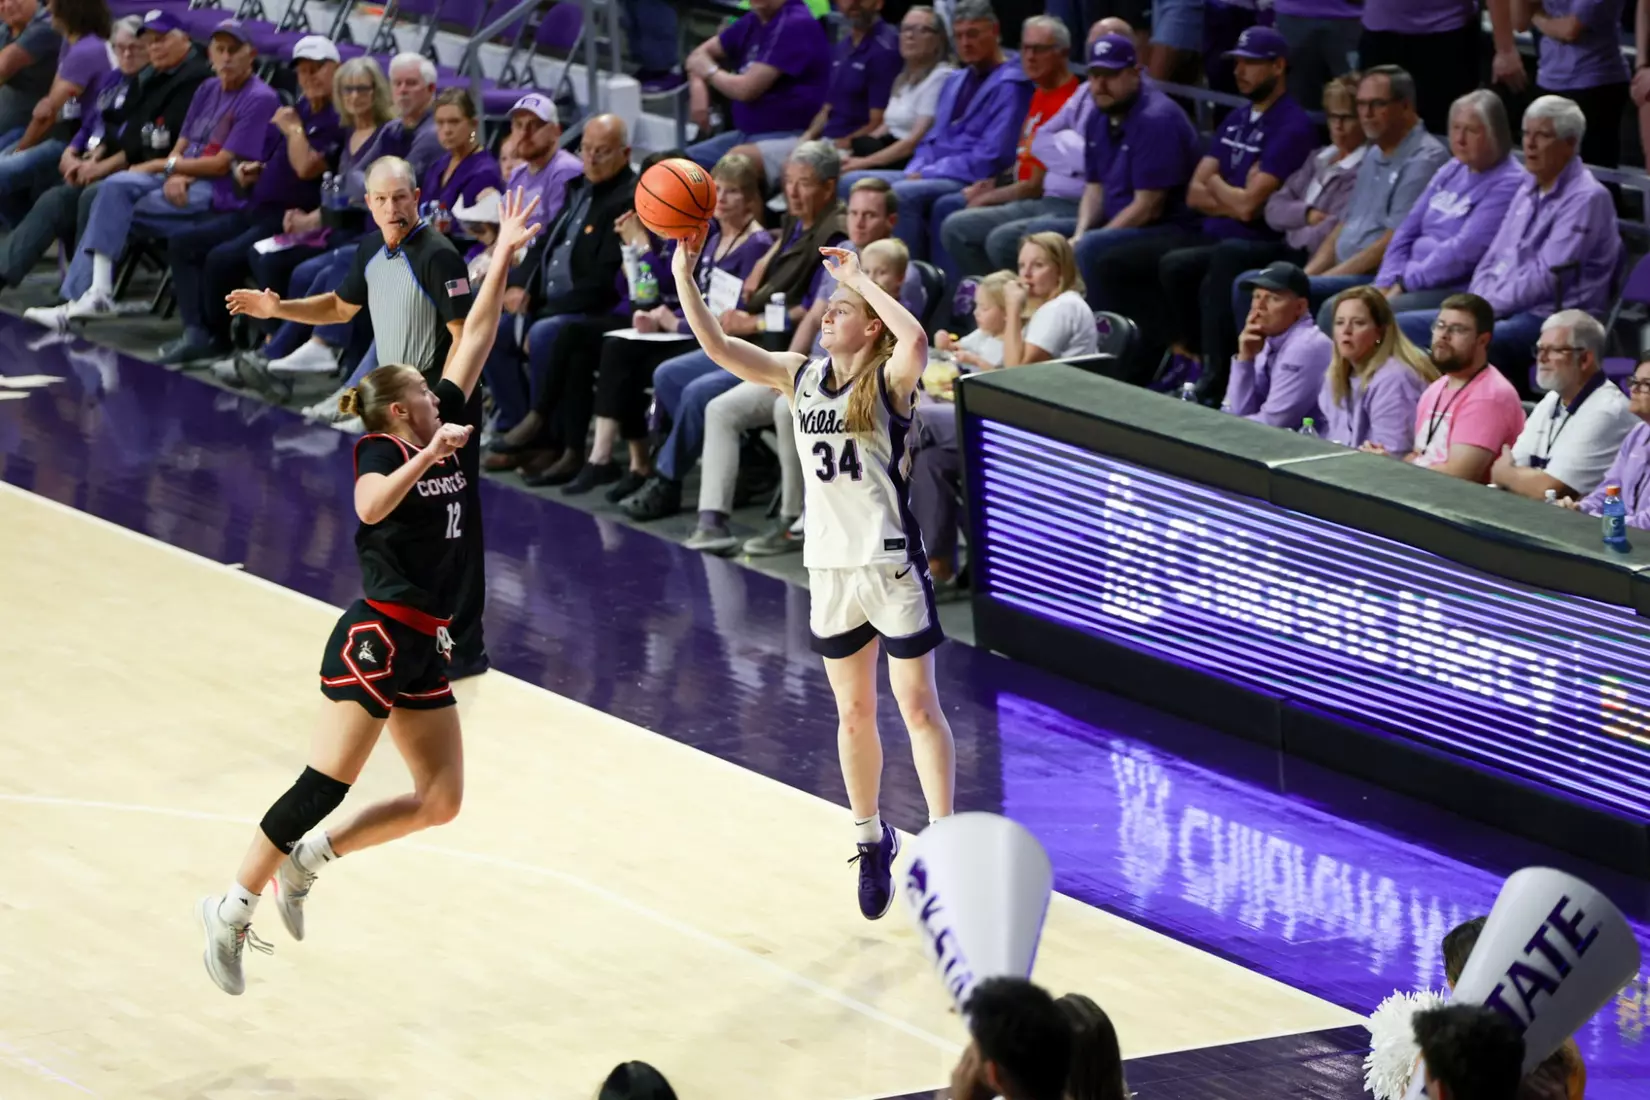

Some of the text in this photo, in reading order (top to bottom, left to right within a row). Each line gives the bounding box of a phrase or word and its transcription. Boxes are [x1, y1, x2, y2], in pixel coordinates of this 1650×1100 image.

[799, 409, 868, 434] Wildc
[812, 438, 863, 483] 34
[417, 470, 468, 497] COYOTS
[445, 502, 462, 538] 12
[1483, 893, 1601, 1034] TATE
